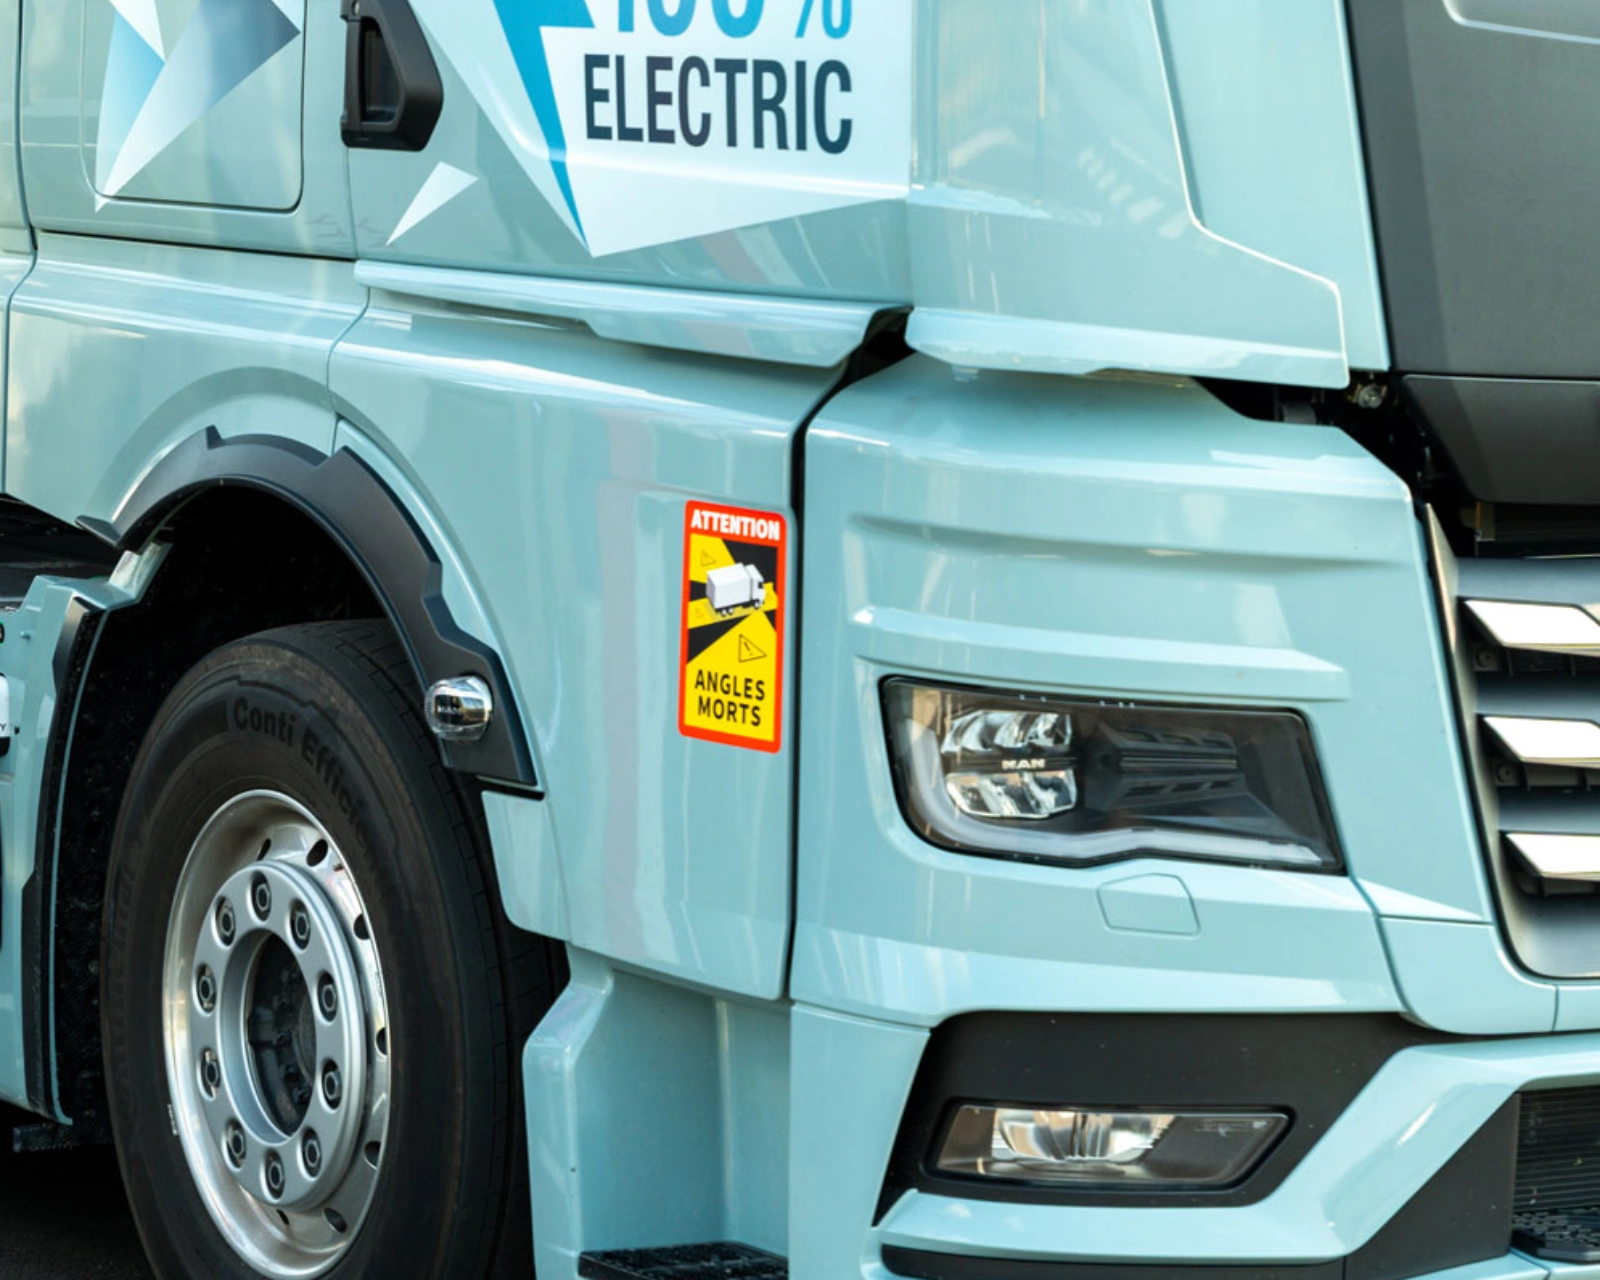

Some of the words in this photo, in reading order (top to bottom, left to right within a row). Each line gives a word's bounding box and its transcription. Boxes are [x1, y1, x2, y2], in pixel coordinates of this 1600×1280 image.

[584, 54, 852, 154] ELECTRIC
[691, 509, 781, 541] ATTENTION
[695, 669, 765, 701] ANGLES
[234, 697, 297, 748] Conti
[698, 696, 761, 726] MORTS
[1001, 758, 1046, 770] MAN
